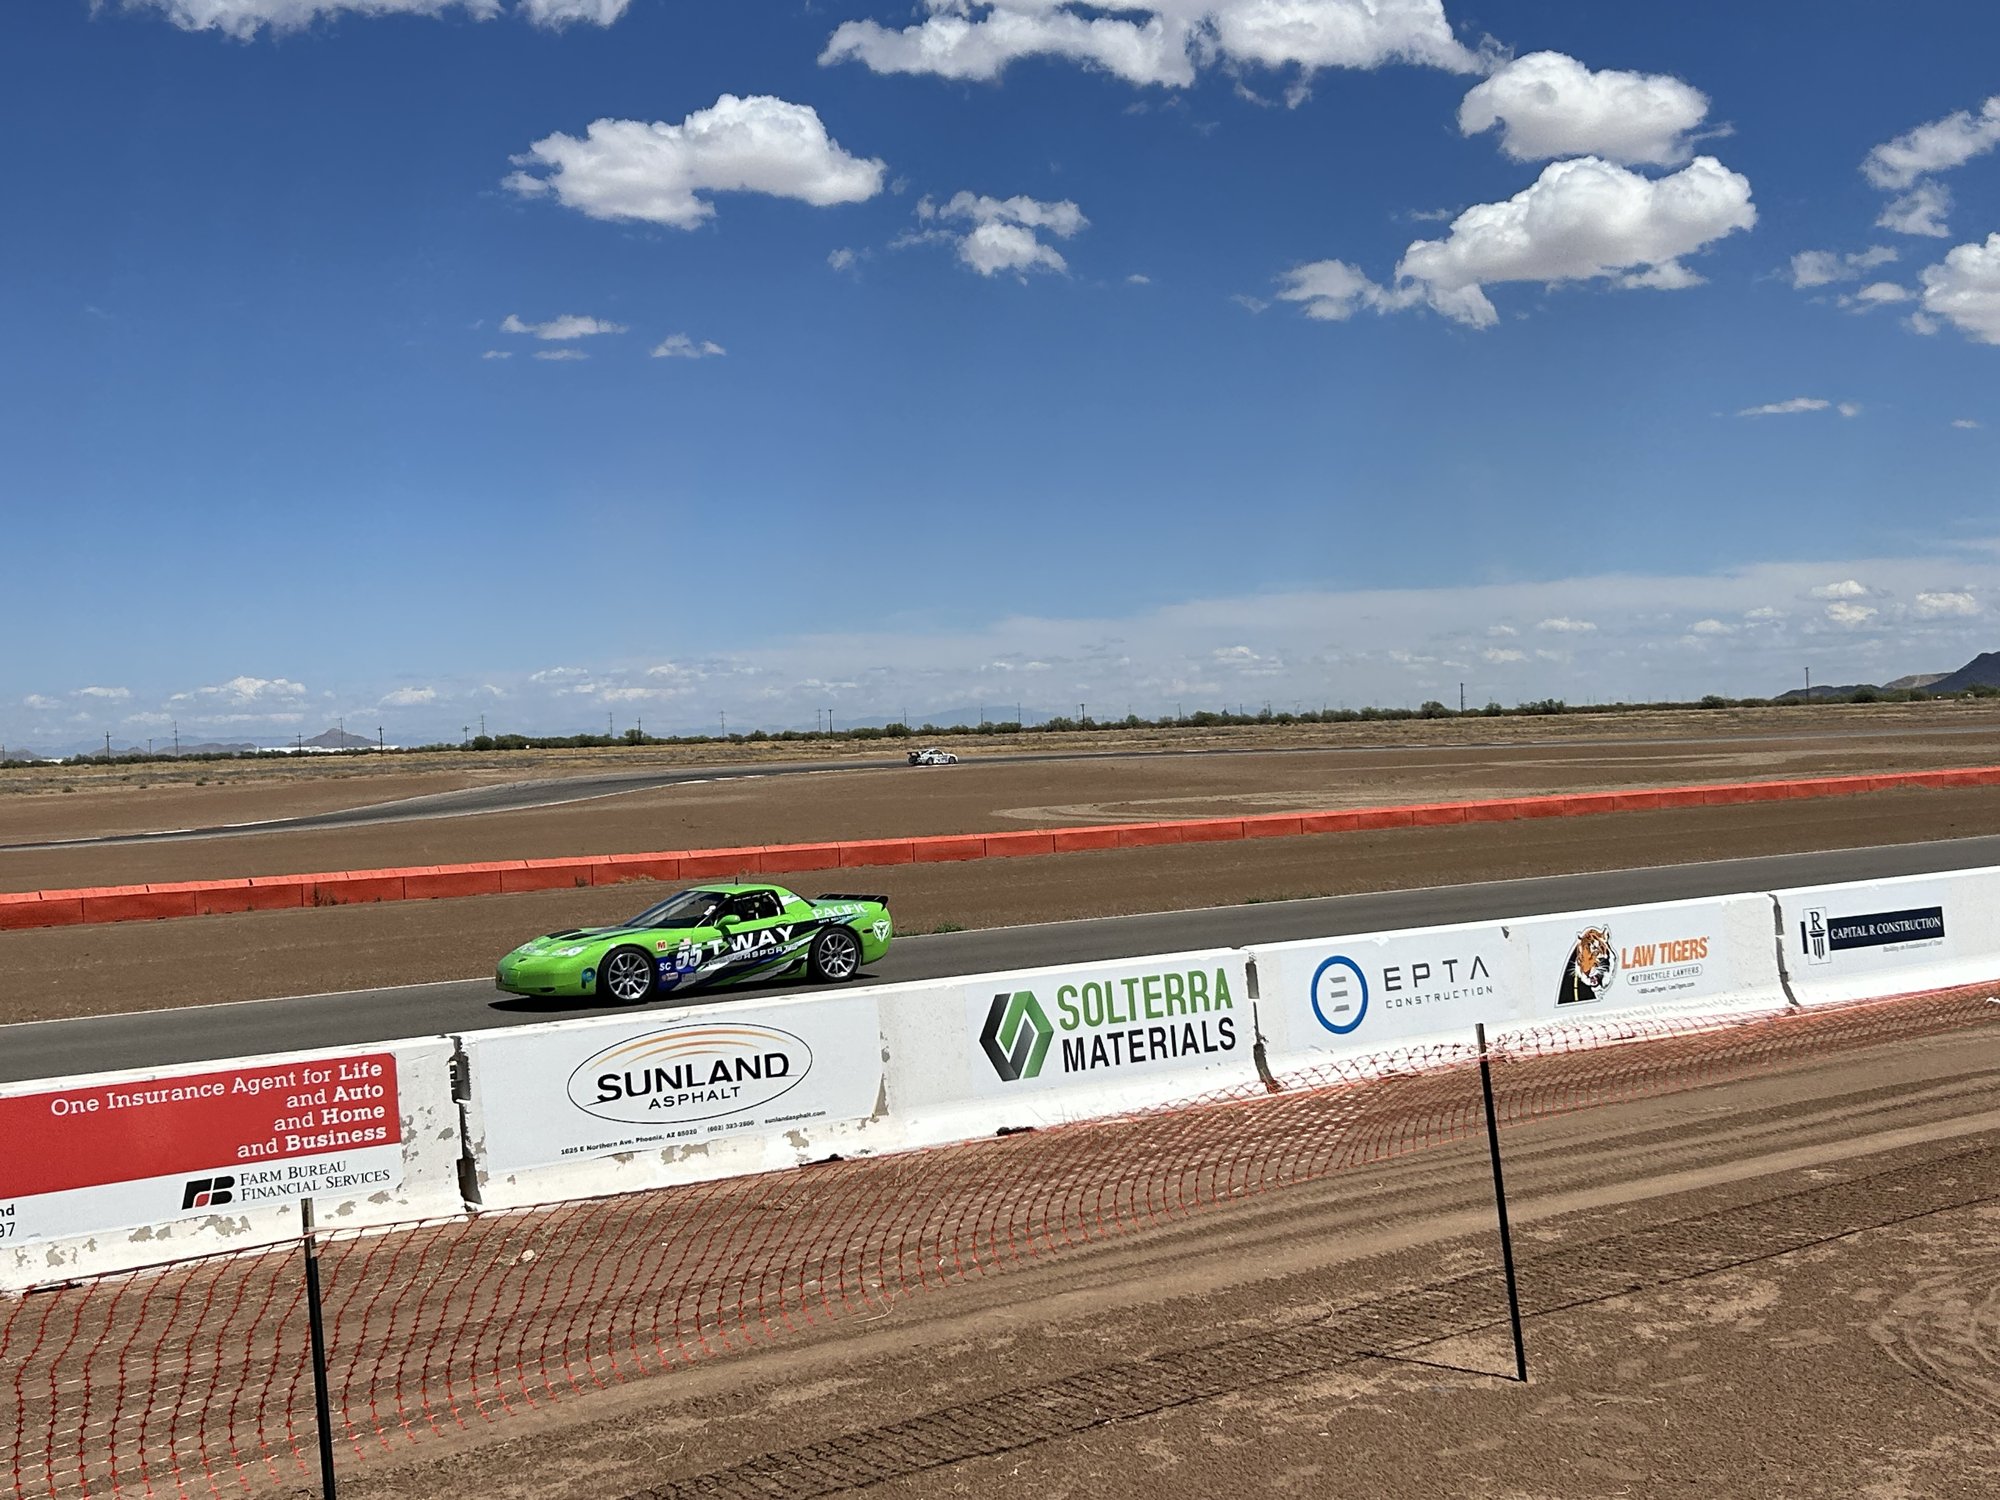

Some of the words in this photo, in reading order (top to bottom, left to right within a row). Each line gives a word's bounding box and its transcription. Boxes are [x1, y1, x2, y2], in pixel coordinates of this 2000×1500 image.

[812, 903, 869, 919] PACIFIC
[1830, 925, 1868, 940] CAPITAL
[1869, 923, 1876, 935] R
[1876, 916, 1942, 935] CONSTRUCTION
[675, 944, 703, 970] 55
[1621, 943, 1656, 970] LAW
[1659, 936, 1708, 965] TIGERS
[659, 962, 671, 971] SC
[1383, 955, 1490, 991] EPTA
[1631, 970, 1670, 983] MOTORCYCLE
[1672, 966, 1699, 977] LAWYERS
[1057, 968, 1234, 1031] SOLTERRA
[1385, 986, 1494, 1009] CONSTRUCTION
[1062, 1017, 1236, 1073] MATERIALS
[51, 1098, 100, 1116] One
[107, 1084, 225, 1109] Insurance
[232, 1072, 296, 1095] Agent
[302, 1068, 331, 1088] for
[338, 1062, 383, 1082] Life
[597, 1053, 791, 1101] SUNLAND
[286, 1091, 327, 1109] and
[333, 1085, 385, 1103] Auto
[648, 1086, 741, 1110] ASPHALT
[274, 1113, 315, 1131] and
[321, 1105, 386, 1126] Home
[587, 1141, 618, 1151] Northern
[666, 1131, 675, 1139] AZ
[764, 1111, 826, 1124] sunlandasphalt.com
[237, 1138, 279, 1158] and
[285, 1127, 387, 1153] Business
[240, 1168, 282, 1186] FARM
[288, 1160, 347, 1179] BUREAU
[241, 1179, 321, 1201] FINANCIAL
[326, 1169, 390, 1189] SERVICES
